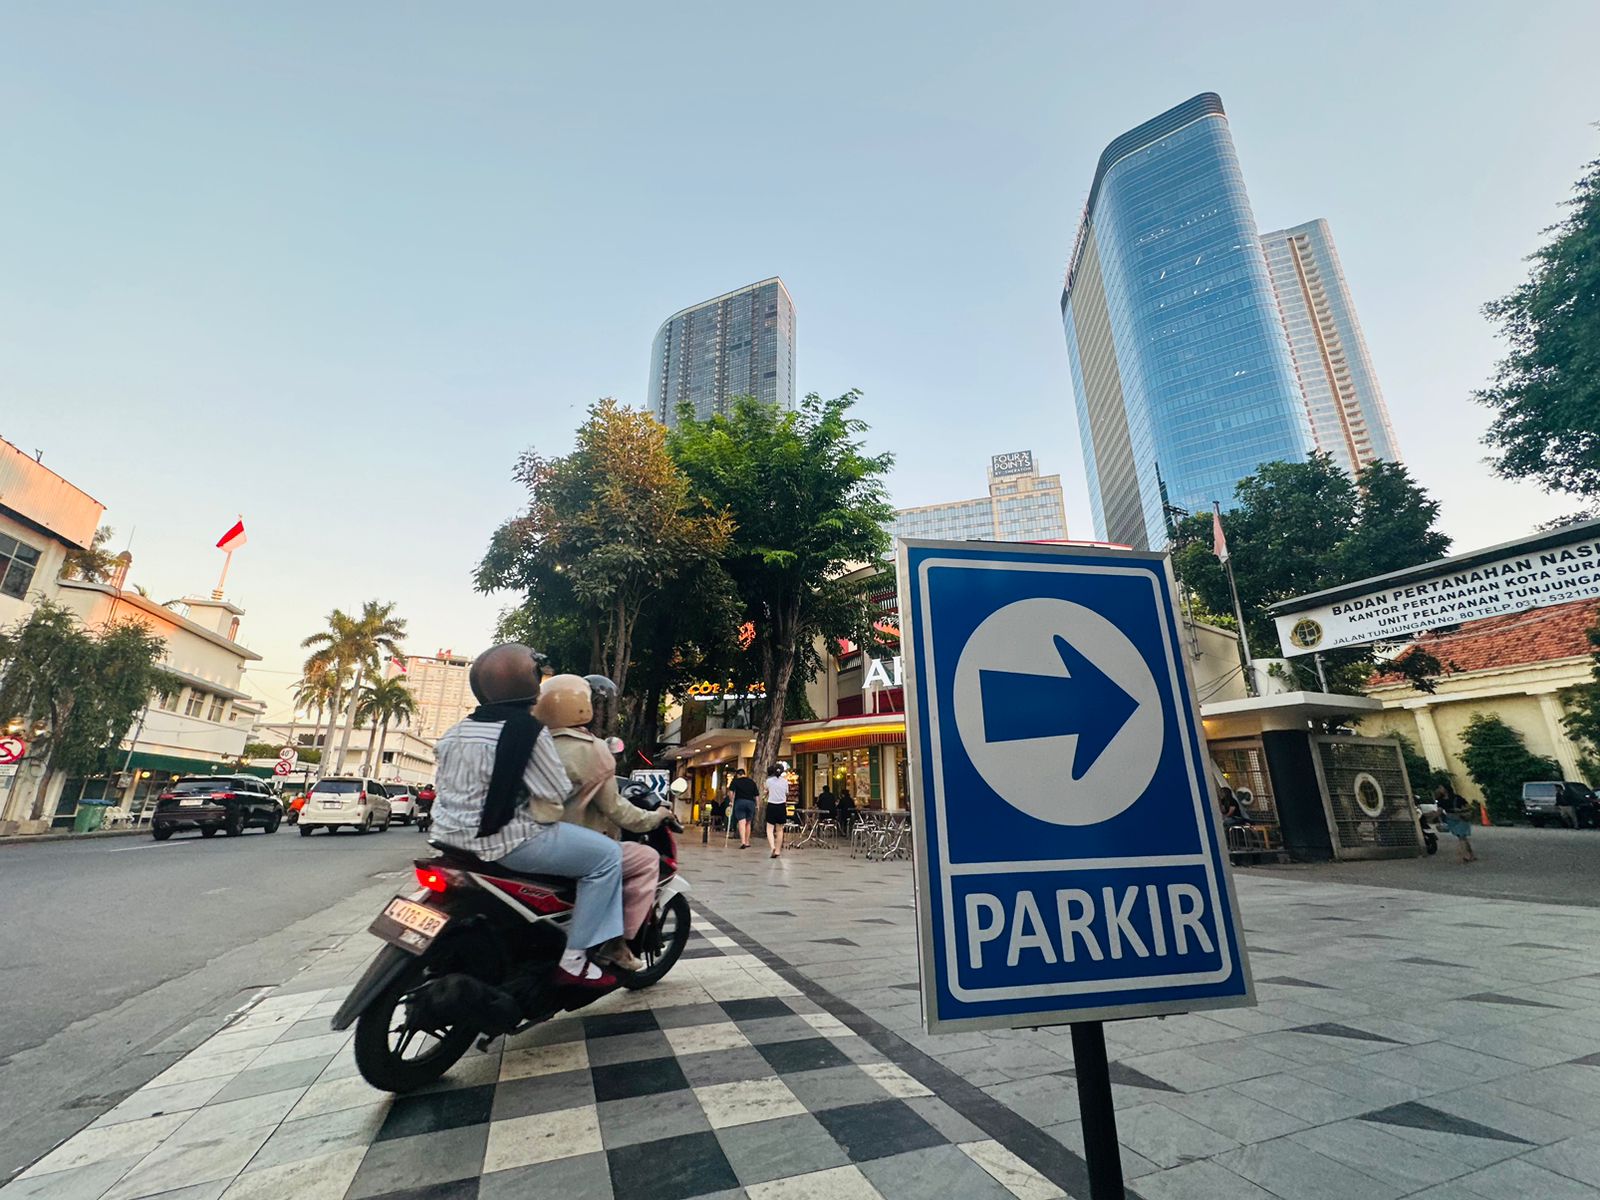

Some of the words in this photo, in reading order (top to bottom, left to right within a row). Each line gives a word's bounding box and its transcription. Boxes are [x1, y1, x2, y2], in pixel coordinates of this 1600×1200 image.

[993, 452, 1020, 463] FOUR
[994, 460, 1031, 471] POINTS
[1332, 594, 1388, 616] BADAN
[1392, 558, 1533, 601] PERTANAHAN
[1348, 605, 1399, 623] KANTOR
[1402, 581, 1500, 611] PERTANAHAN
[1504, 570, 1551, 588] KOTA
[1555, 559, 1600, 576] SUR
[1378, 613, 1409, 627] UNIT
[1412, 594, 1500, 620] PELAYANAN
[1333, 633, 1366, 646] JALAN
[1367, 616, 1436, 638] TUNJUNGAN
[1437, 616, 1458, 624] No.
[1459, 610, 1474, 619] 80
[1475, 603, 1514, 616] TELP.
[1515, 598, 1538, 609] 031
[965, 883, 1215, 969] PARKIR
